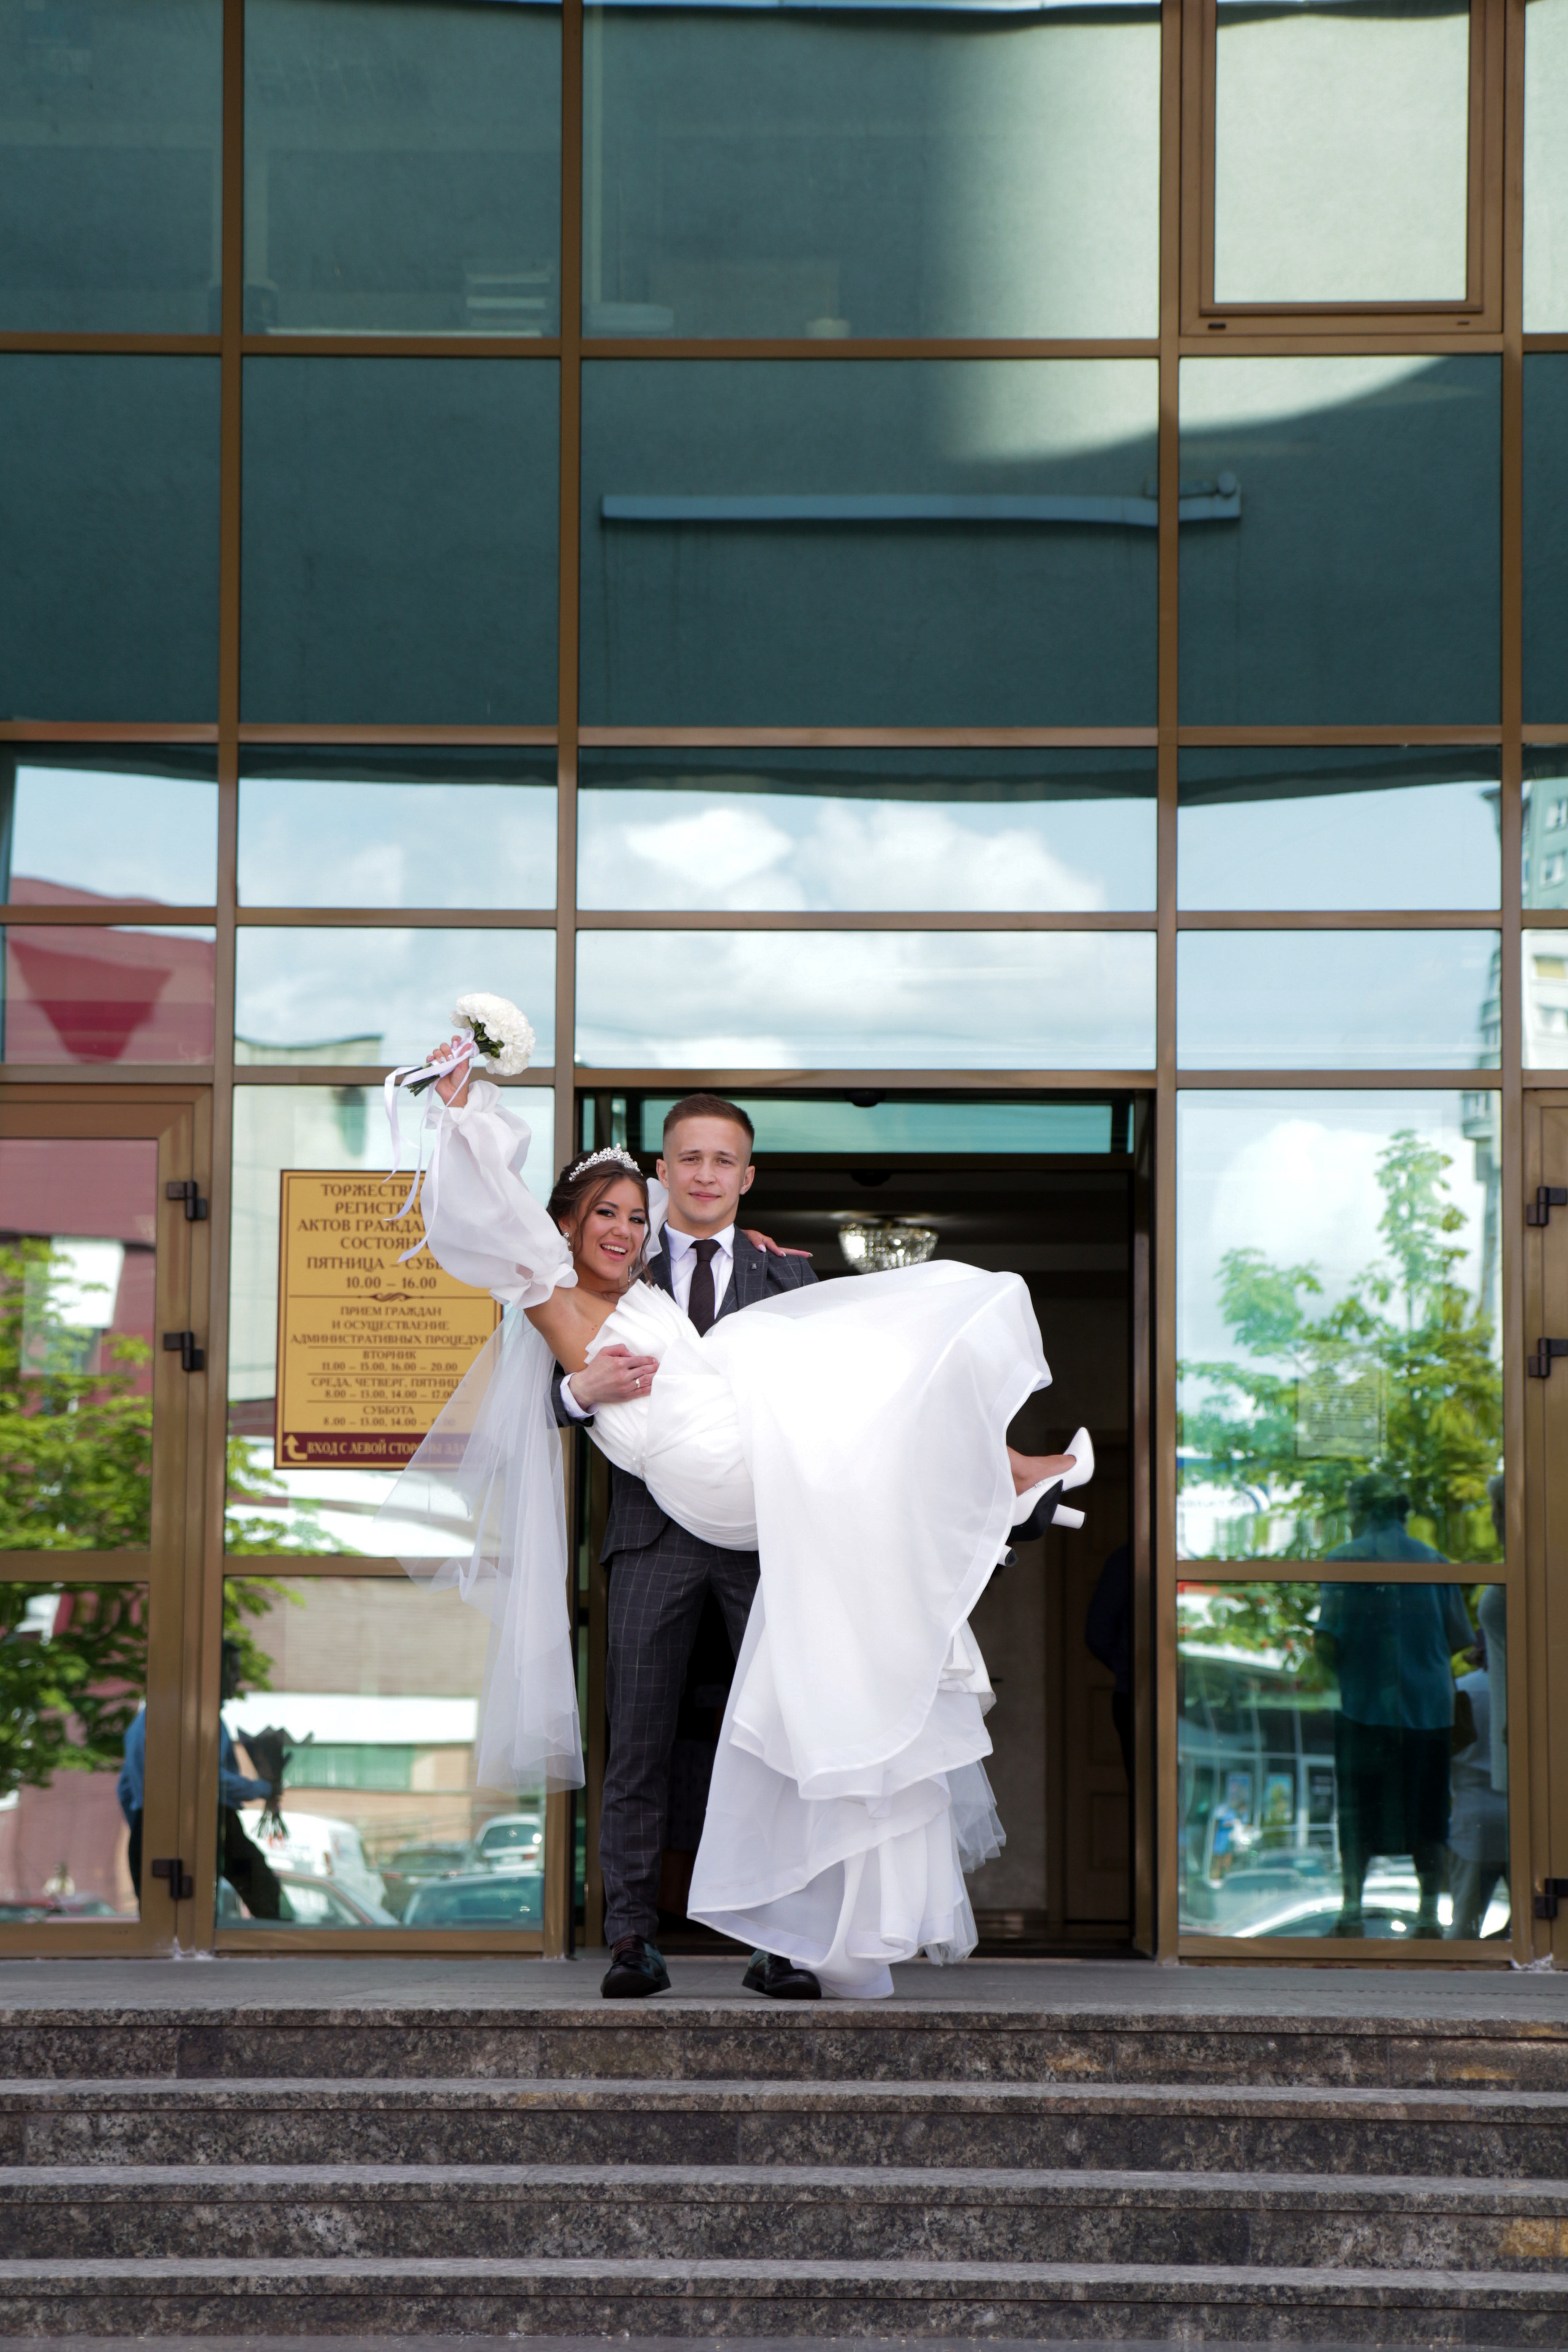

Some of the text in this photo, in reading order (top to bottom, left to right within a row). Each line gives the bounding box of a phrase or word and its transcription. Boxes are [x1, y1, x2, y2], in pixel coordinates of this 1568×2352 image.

[297, 1218, 426, 1234] АКТОВ ГРАЖДА
[339, 1235, 429, 1251] СОСТОЯН
[306, 1256, 385, 1273] ПЯТНИЦА
[346, 1276, 382, 1289] 10.00
[402, 1276, 437, 1289] 16.00
[340, 1305, 442, 1318] ПРИЕМ ГРАЖДАН
[331, 1319, 450, 1333] И ОСУЩЕСТВЛЕНИЕ
[290, 1333, 488, 1346] АДМИНИСТРАТИВНЫХ ПРОЦЕДУР
[363, 1349, 417, 1360] ВТОРНИК
[322, 1361, 346, 1371] 11.00
[391, 1362, 417, 1372] 16.00
[430, 1362, 458, 1372] 20.00
[391, 1390, 417, 1399] 14.00
[362, 1405, 415, 1415] СУББОТА
[391, 1417, 417, 1427] 14.00
[307, 1441, 338, 1457] ВХОД
[349, 1439, 387, 1455] ЛЕВОЙ
